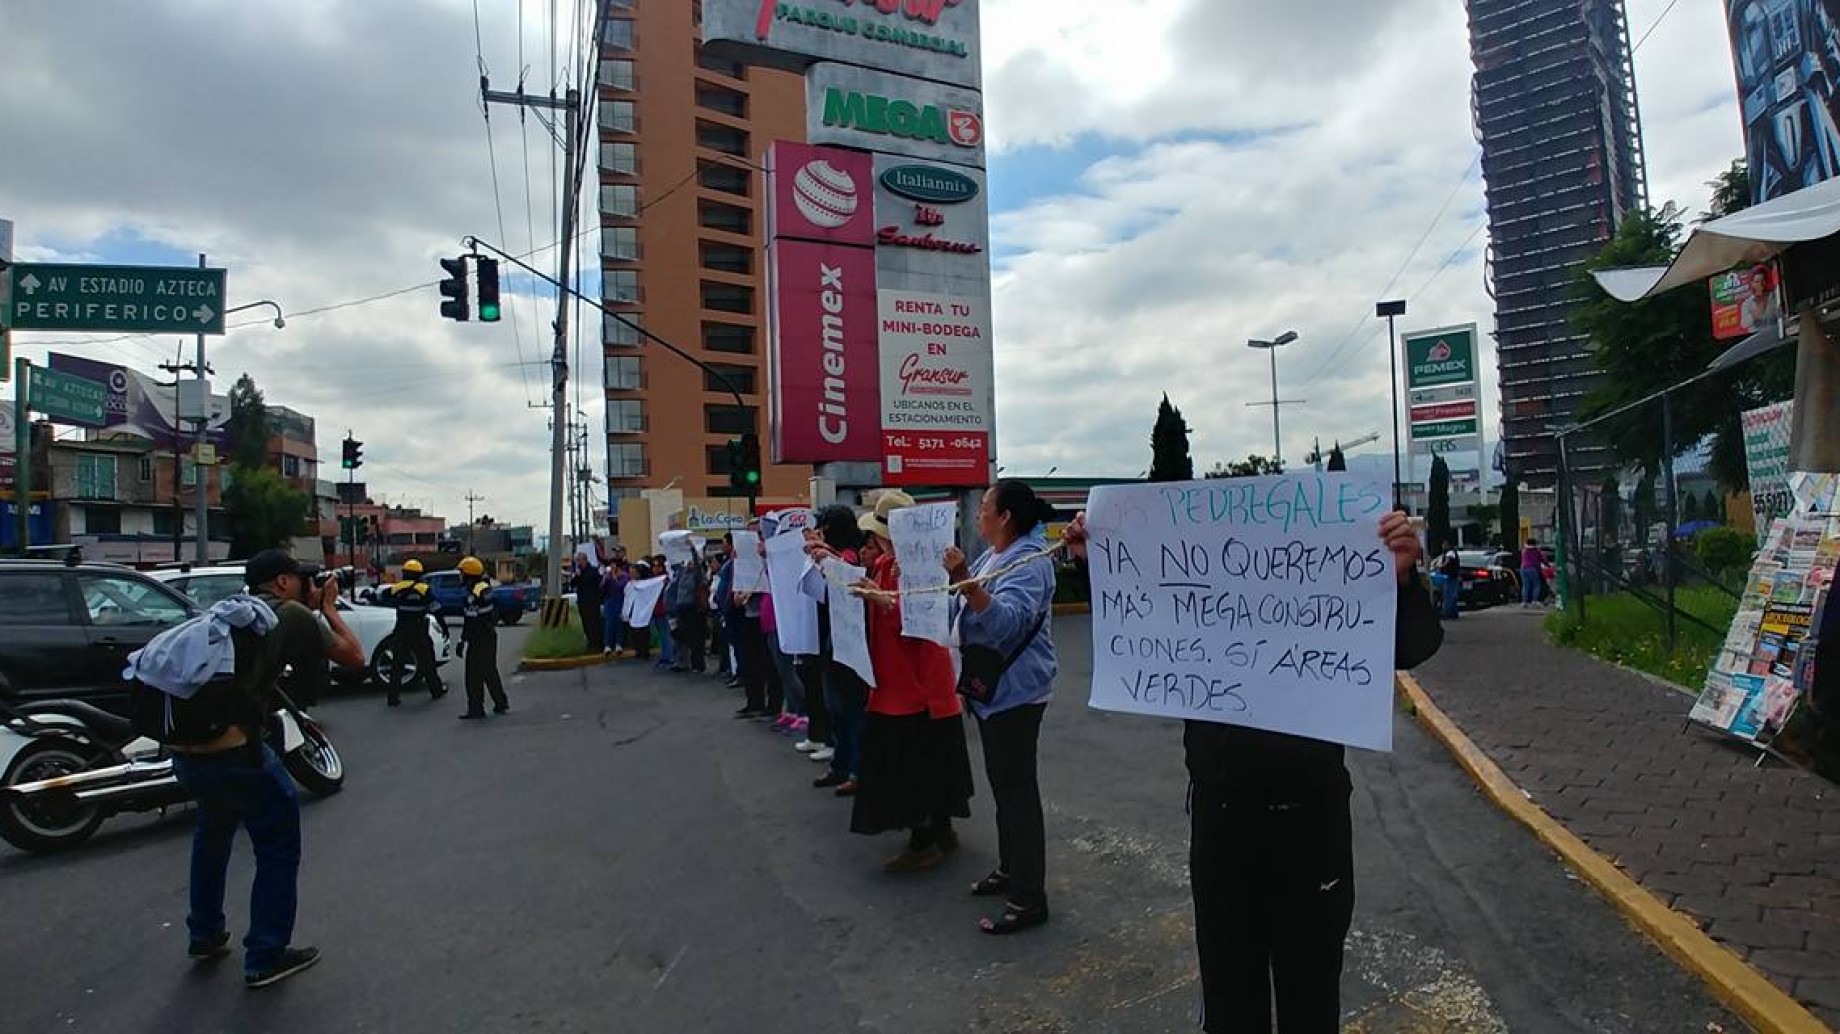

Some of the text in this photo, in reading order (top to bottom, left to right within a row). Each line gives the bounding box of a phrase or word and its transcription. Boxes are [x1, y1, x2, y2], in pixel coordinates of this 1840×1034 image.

[776, 4, 857, 35] PARQUE
[862, 20, 968, 58] COMERCIAL
[822, 87, 948, 143] MEGA
[47, 276, 216, 298] AV ESTADIO AZTECA
[16, 301, 188, 321] PERIFERICO
[895, 300, 970, 317] RENTA TU
[882, 320, 981, 338] MINI-BODEGA
[818, 262, 848, 444] Cinemex
[927, 343, 947, 355] EN
[899, 353, 969, 395] Gransur
[1414, 360, 1466, 375] PEMEX
[893, 400, 973, 411] UBICANOS EN EL
[888, 413, 982, 425] ESTACIONAMIENTO
[919, 438, 944, 449] 5171
[1160, 477, 1383, 534] PEDREGALES
[1095, 538, 1385, 585] YA NO QUEREMOS
[1110, 635, 1213, 665] CIONES.
[1269, 645, 1372, 686] ÁREAS
